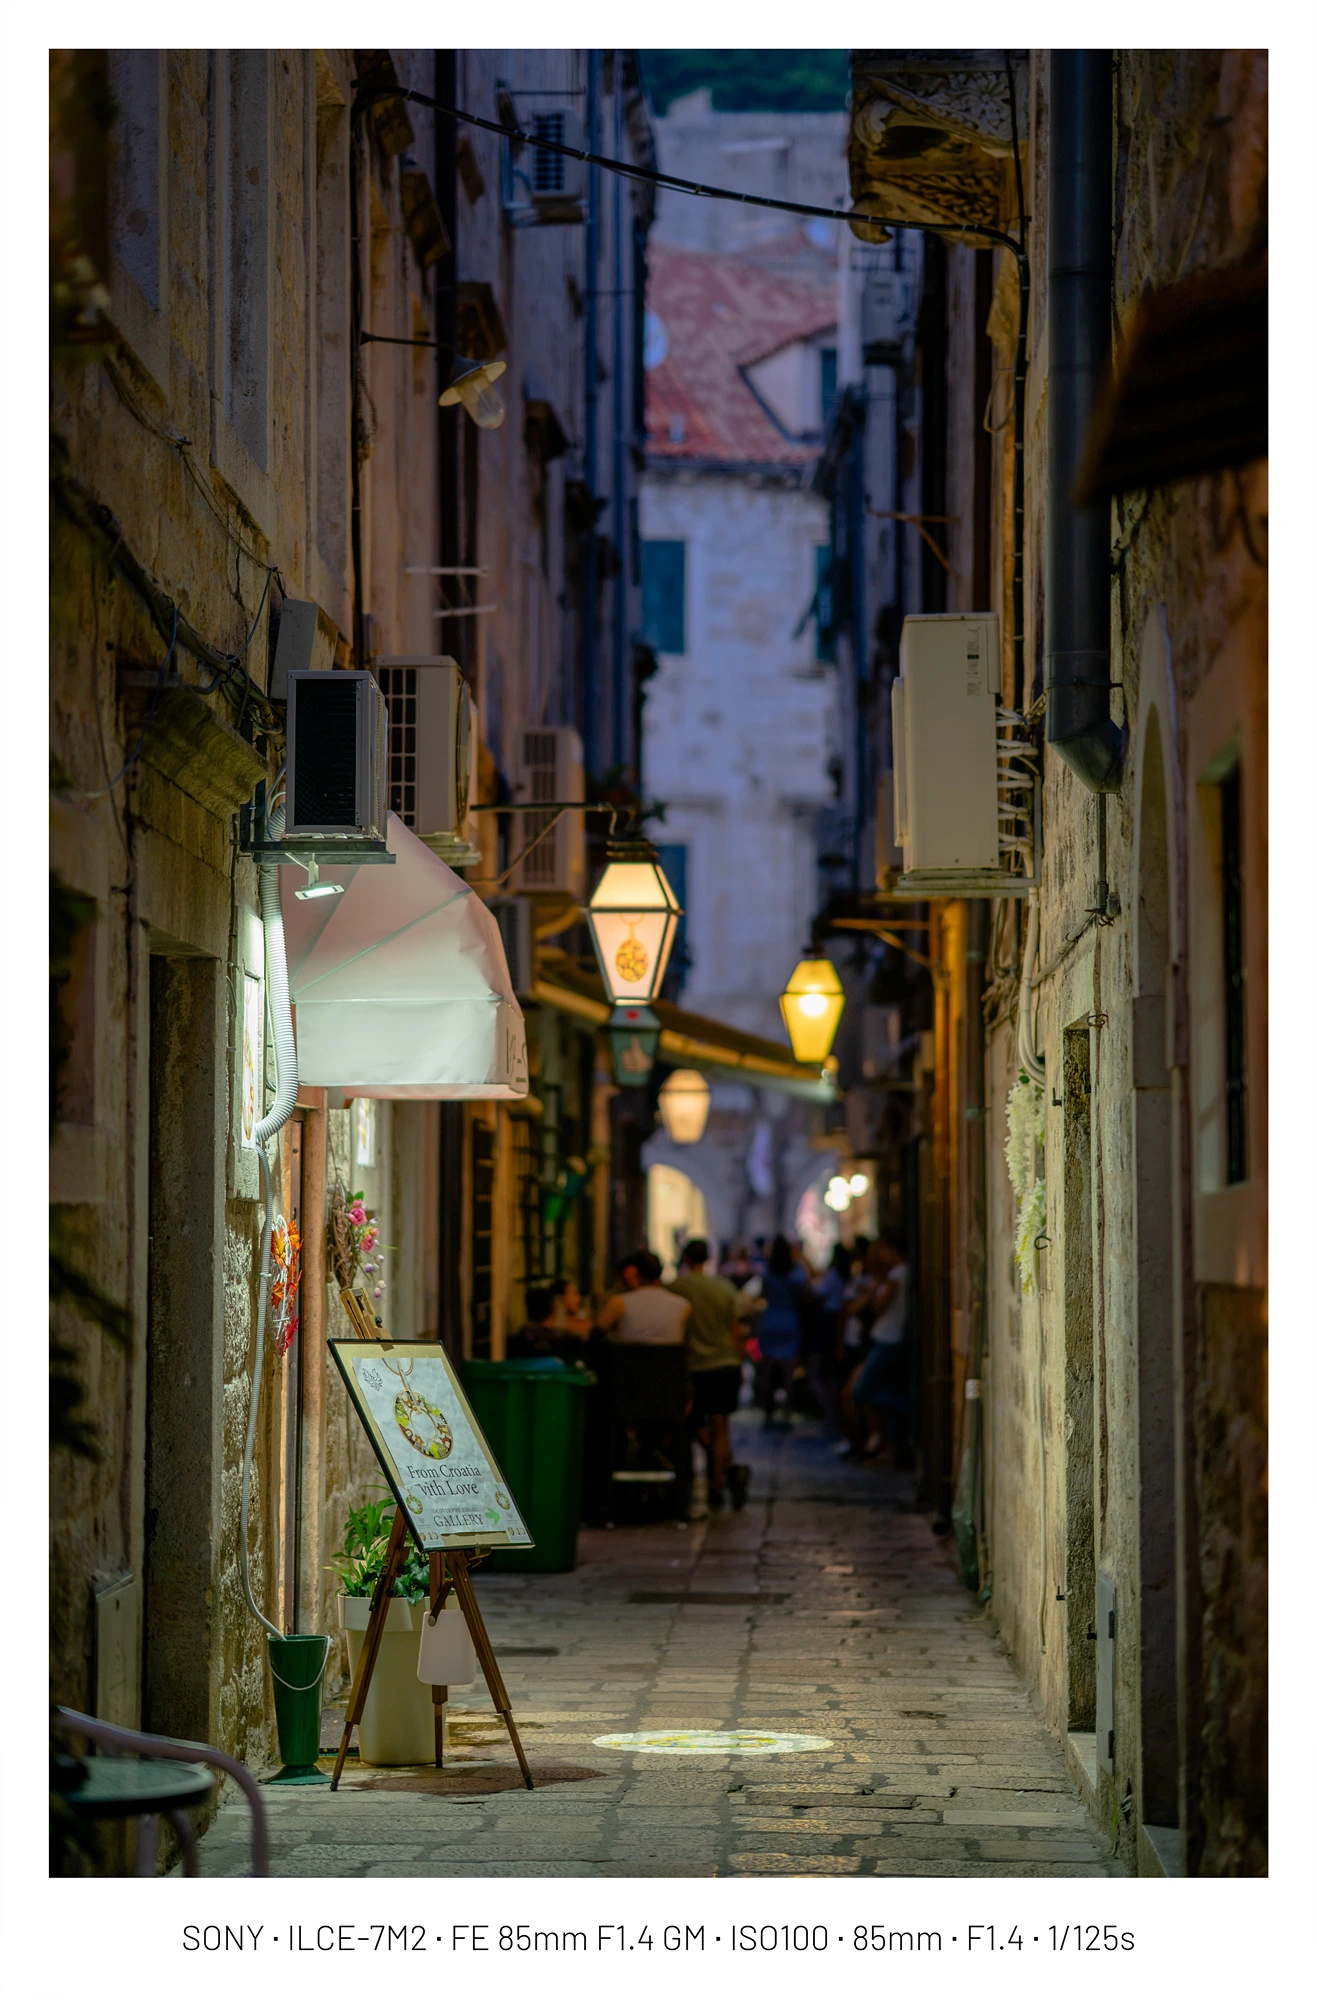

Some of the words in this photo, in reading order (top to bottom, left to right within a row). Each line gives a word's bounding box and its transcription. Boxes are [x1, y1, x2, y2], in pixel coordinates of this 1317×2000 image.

[406, 1465, 439, 1479] From
[439, 1464, 482, 1478] Croatia
[445, 1480, 479, 1496] Love
[433, 1514, 484, 1528] GALLERY
